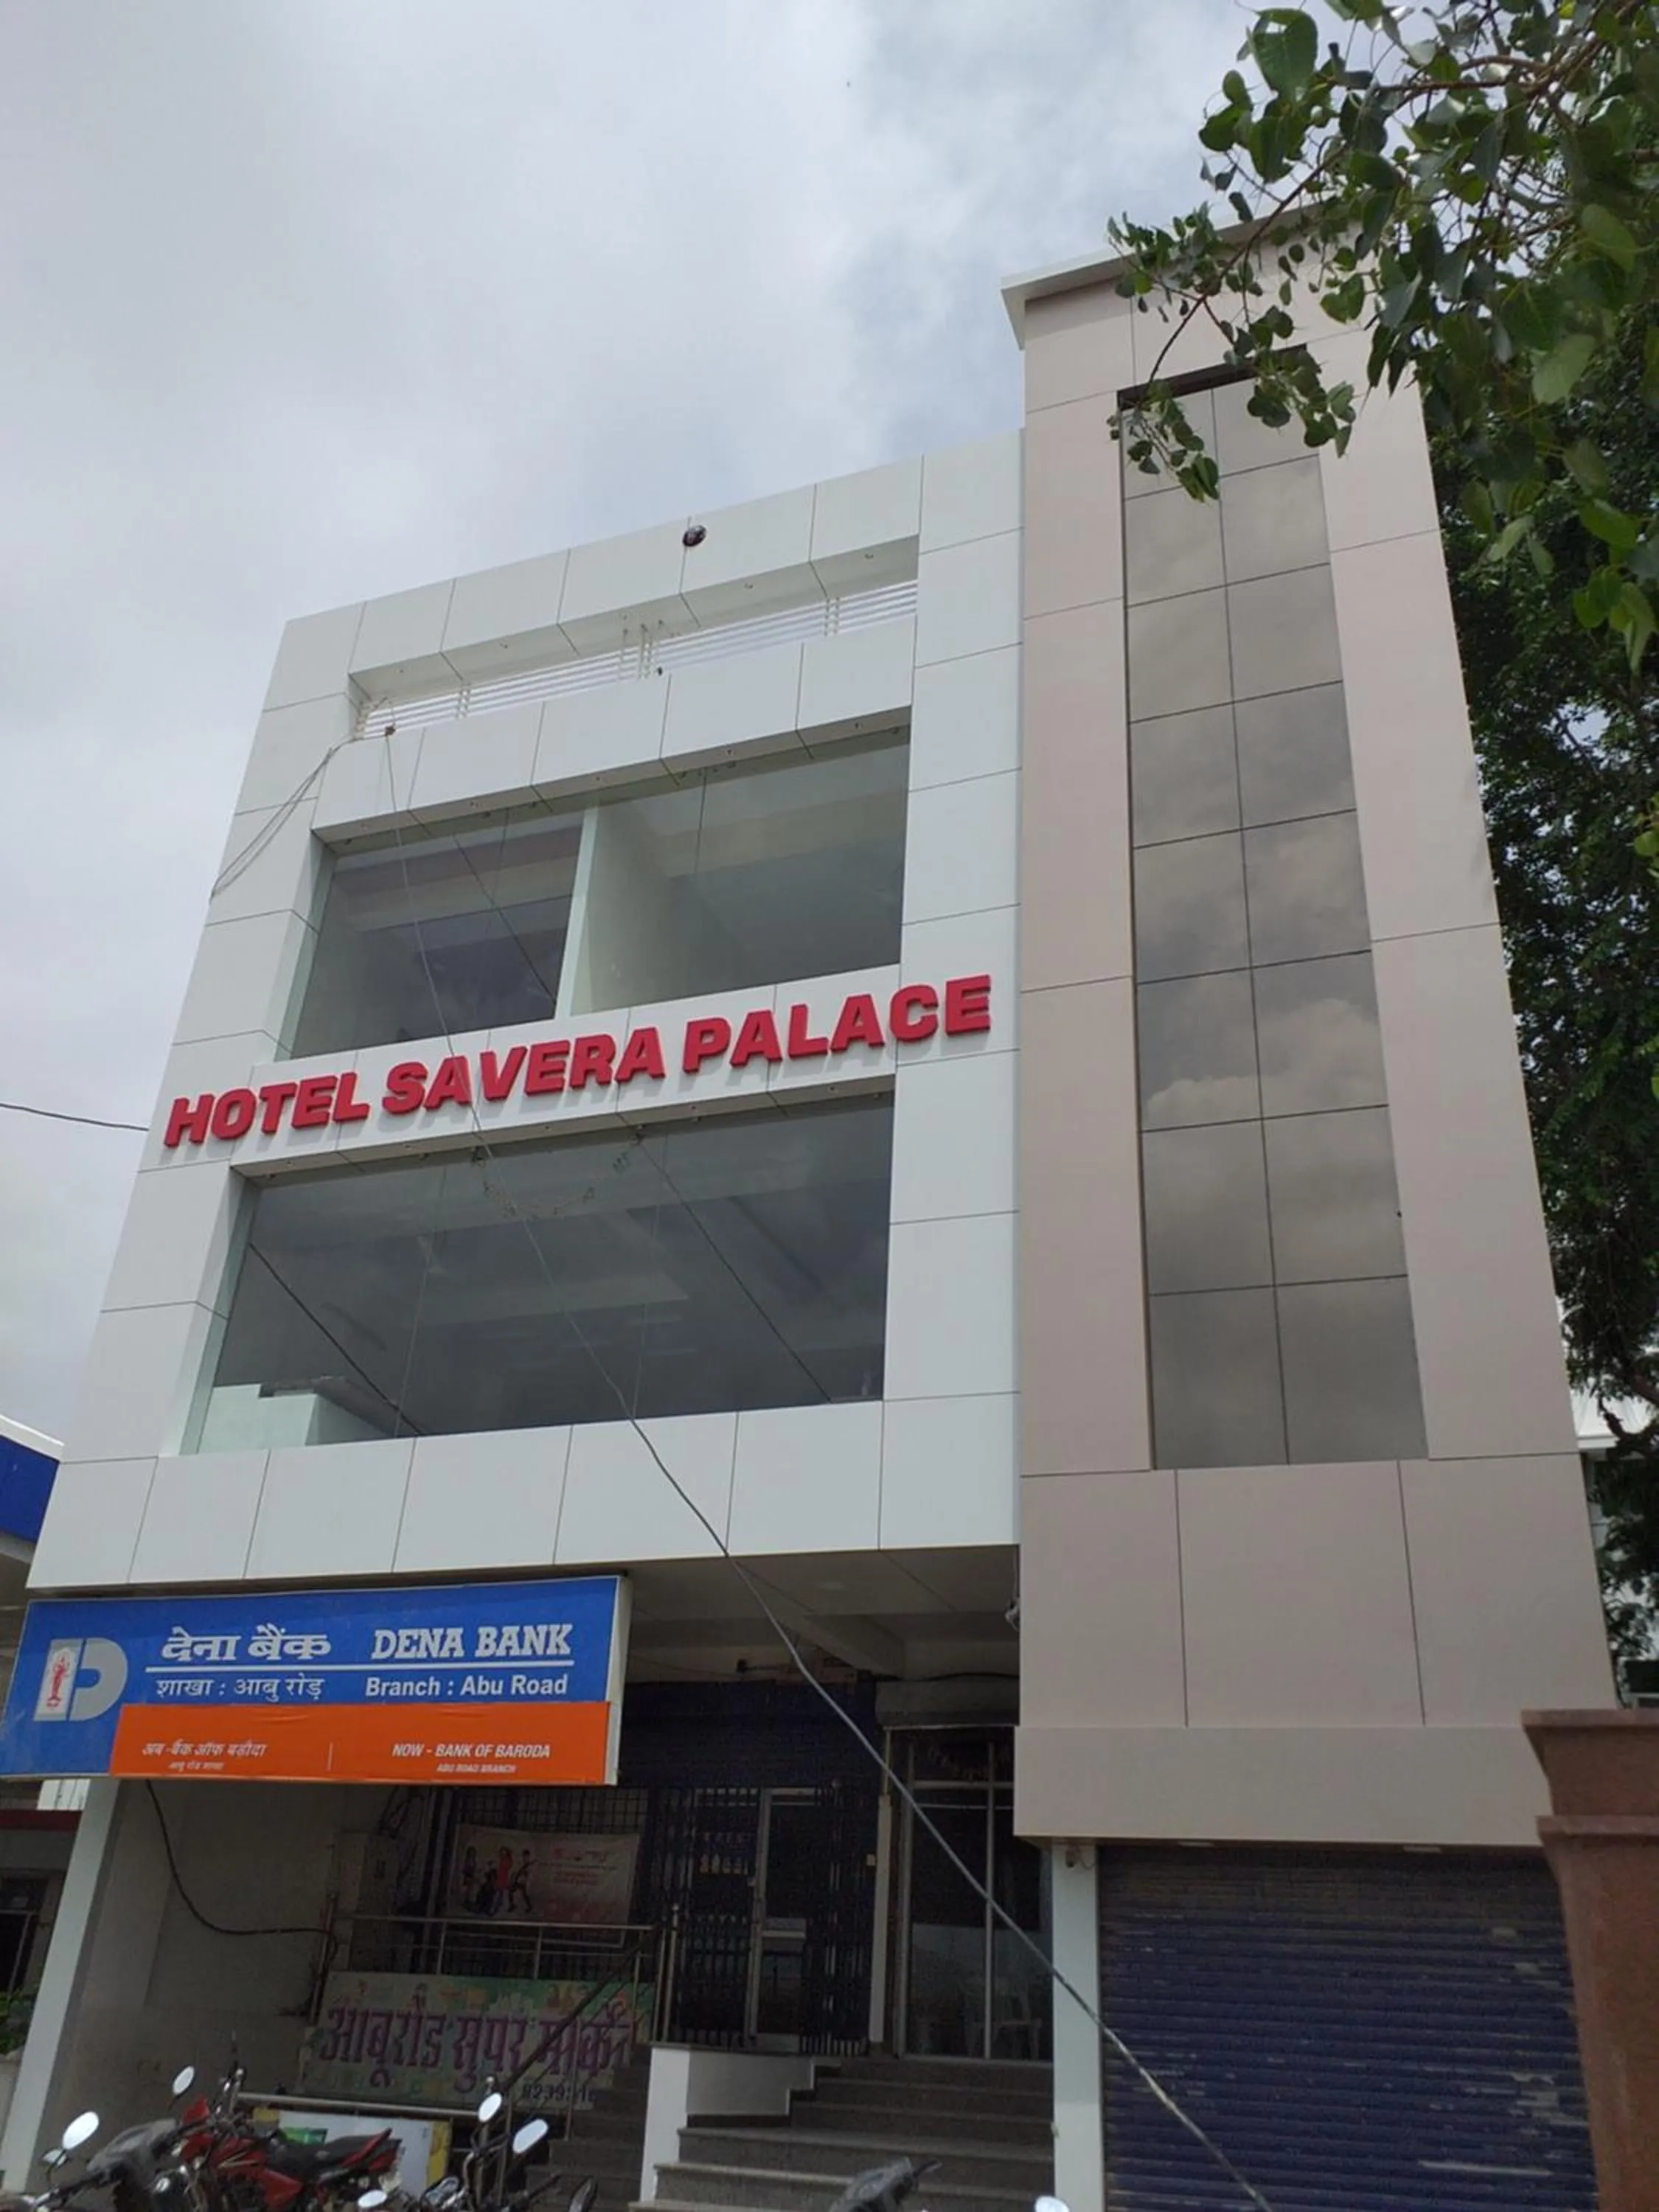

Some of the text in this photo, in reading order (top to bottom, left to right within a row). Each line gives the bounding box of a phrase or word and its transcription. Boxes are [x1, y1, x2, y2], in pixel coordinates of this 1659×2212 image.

[163, 974, 991, 1147] HOTEL SAVERA PALACE
[161, 1622, 332, 1662] देना बैंक
[371, 1624, 574, 1660] DENA BANK
[156, 1677, 215, 1698] शाखा
[233, 1677, 281, 1703] आबु
[285, 1672, 325, 1700] रोड़
[365, 1675, 441, 1697] Branch
[460, 1674, 504, 1696] Abu
[510, 1672, 568, 1696] Road
[392, 1743, 425, 1757] NOW
[434, 1743, 473, 1758] BANK
[474, 1744, 495, 1758] OF
[495, 1744, 551, 1759] BARODA
